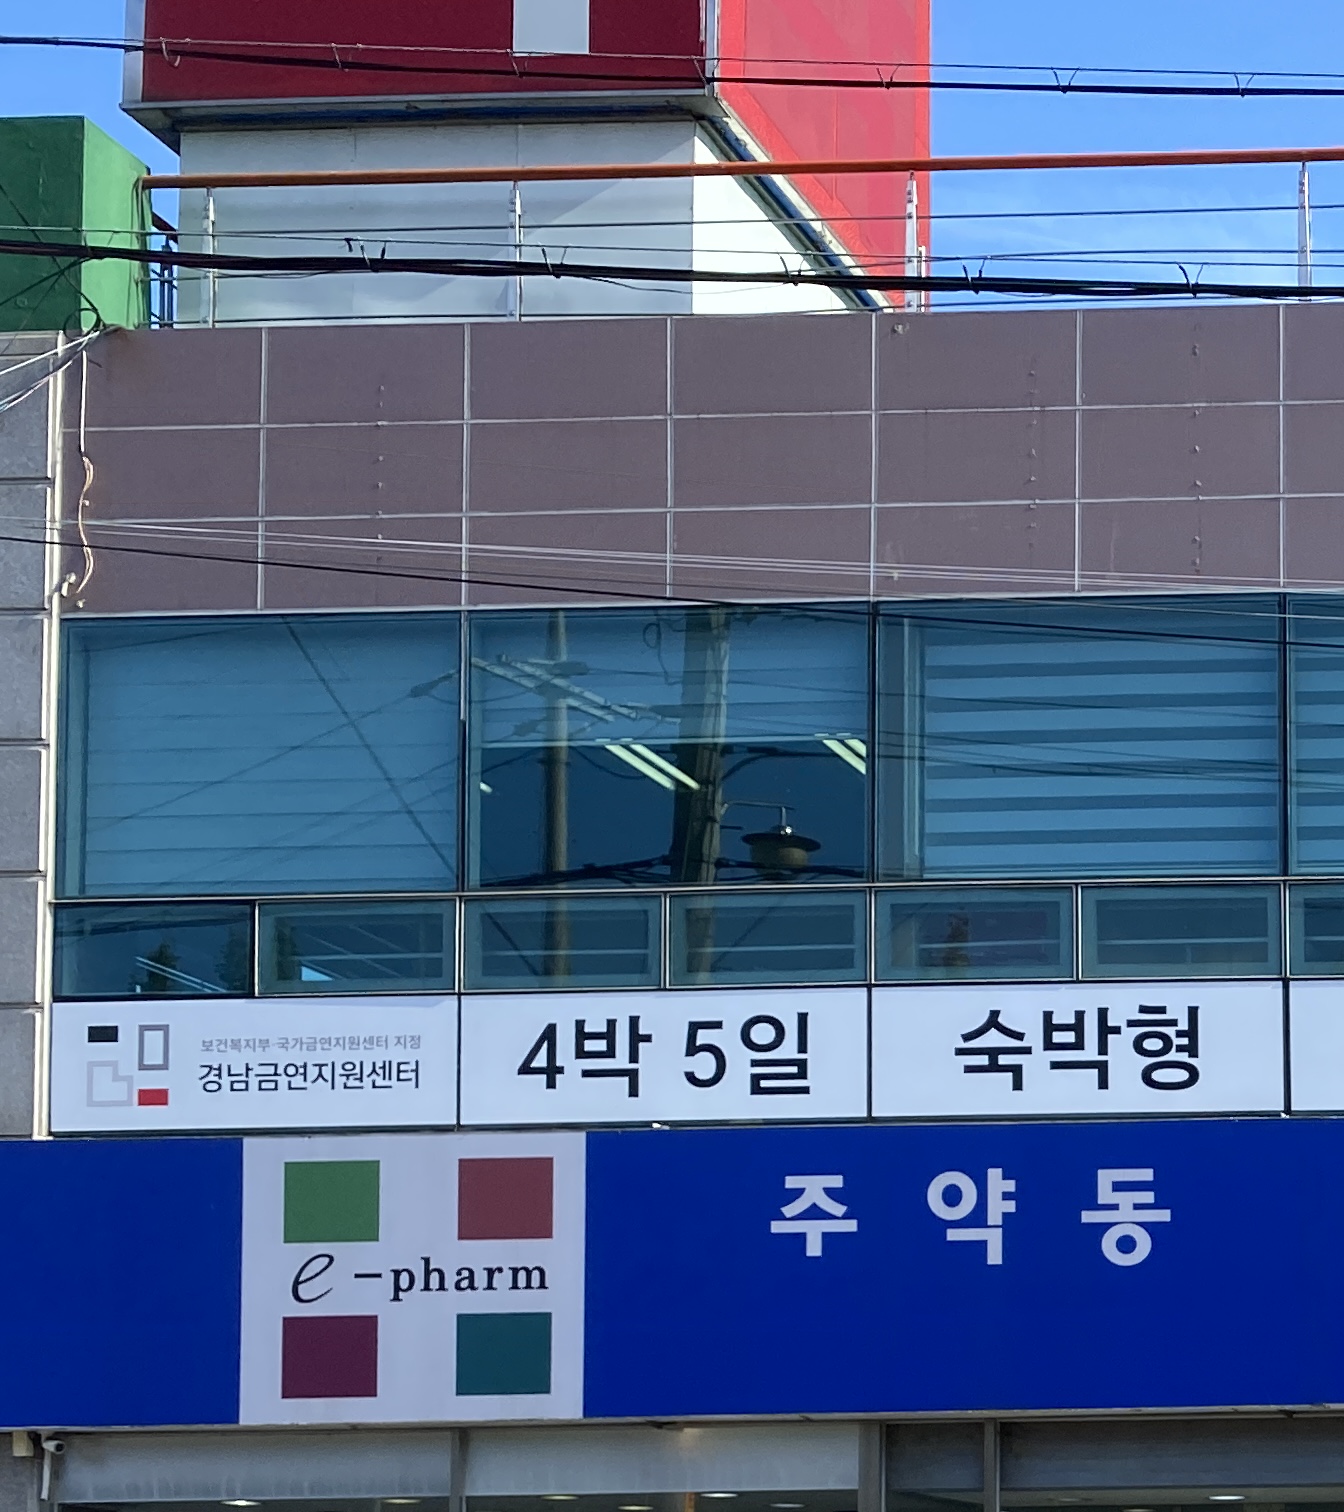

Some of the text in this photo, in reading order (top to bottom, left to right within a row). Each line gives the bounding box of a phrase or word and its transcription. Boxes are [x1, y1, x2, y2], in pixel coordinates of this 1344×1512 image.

[394, 1034, 421, 1050] 지정
[518, 1016, 652, 1097] 4박
[684, 1012, 811, 1095] 5일
[955, 1005, 1200, 1091] 숙박형
[199, 1060, 419, 1092] 경남금연지원센터
[770, 1167, 1172, 1267] 주약동
[291, 1253, 549, 1304] e-pharm
